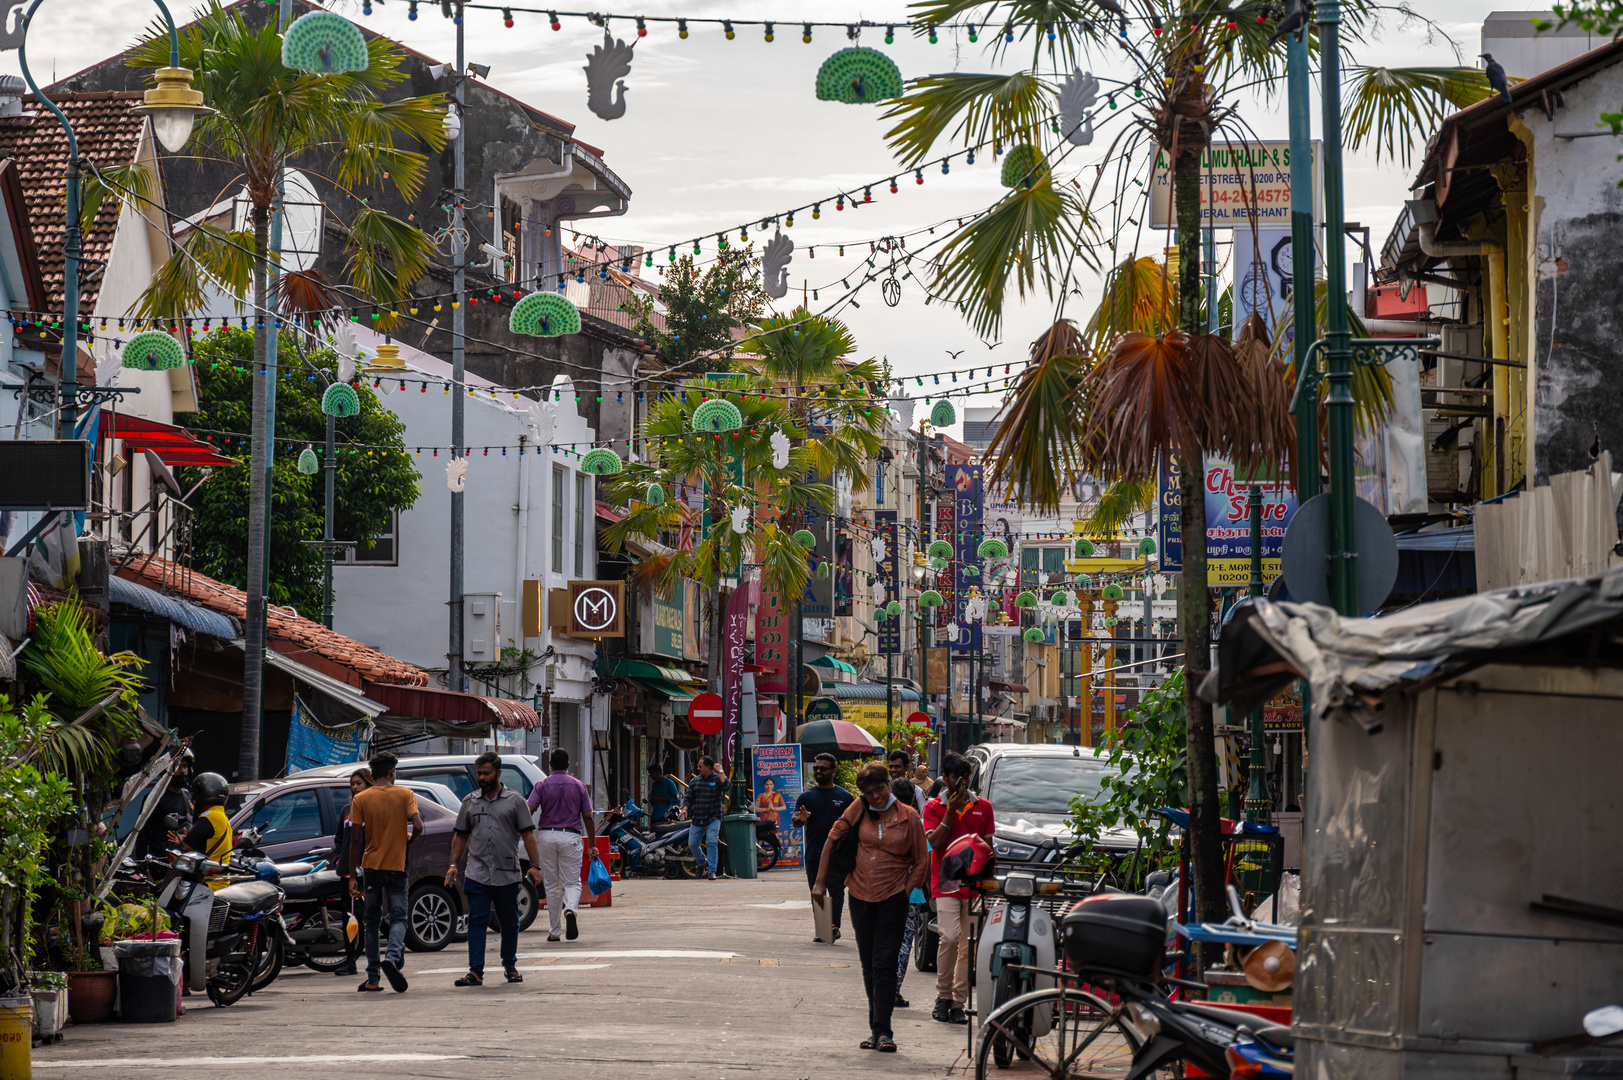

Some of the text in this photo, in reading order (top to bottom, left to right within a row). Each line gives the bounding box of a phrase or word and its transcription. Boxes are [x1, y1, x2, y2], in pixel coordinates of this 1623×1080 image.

[1212, 149, 1268, 168] MUTHALIF
[1211, 174, 1247, 185] STREET,
[1250, 173, 1274, 183] 0200
[1232, 207, 1288, 217] MERCHANT
[759, 747, 793, 756] DEVAN
